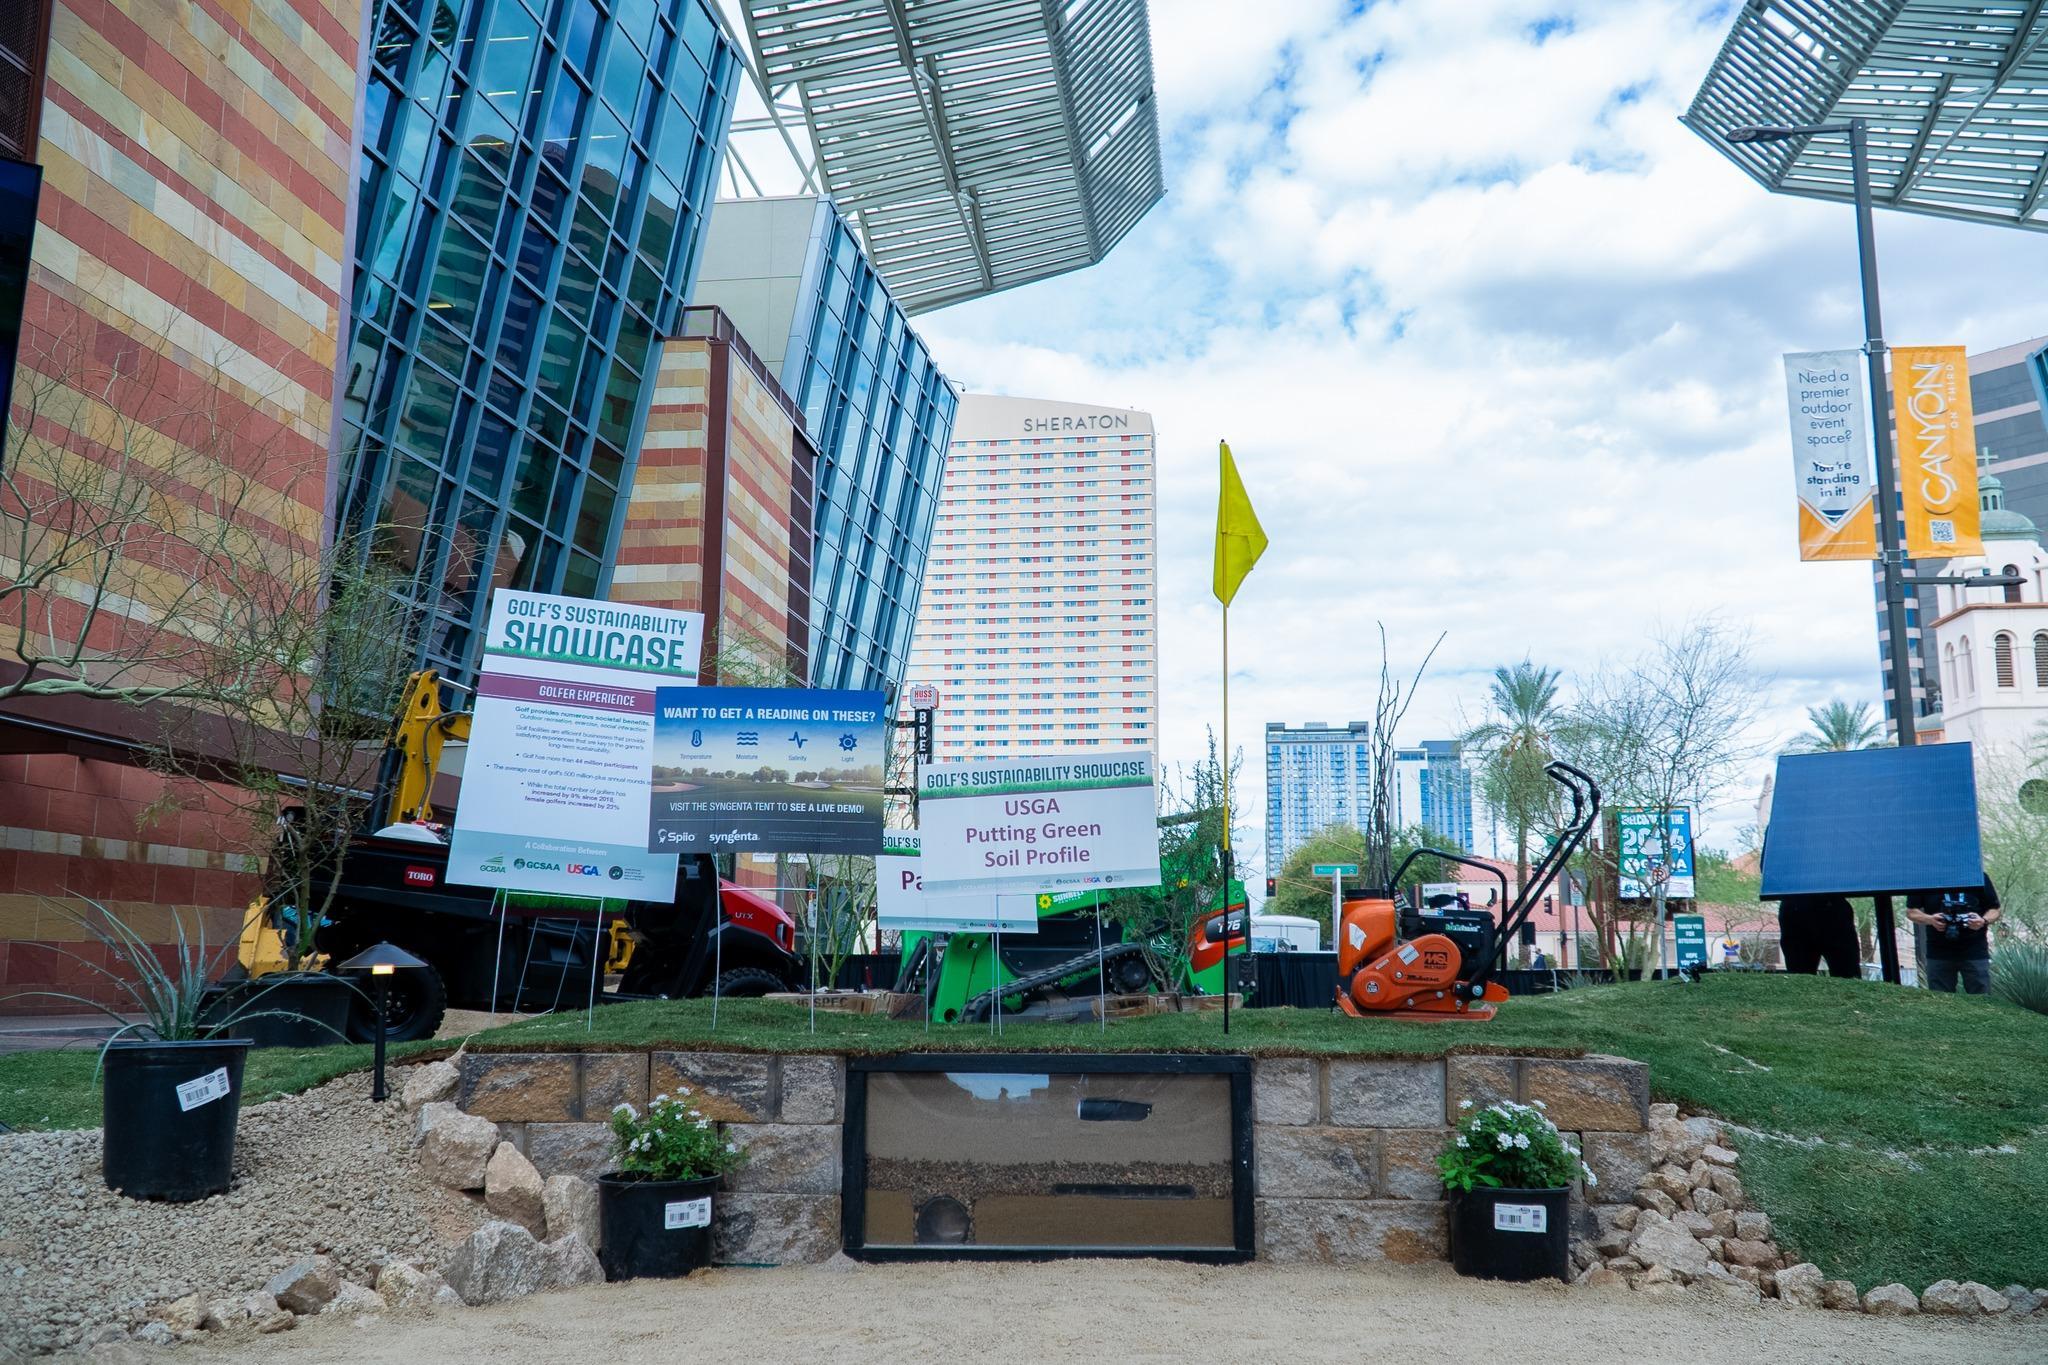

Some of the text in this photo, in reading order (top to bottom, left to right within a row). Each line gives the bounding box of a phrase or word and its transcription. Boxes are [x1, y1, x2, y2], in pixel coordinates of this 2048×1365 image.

[1798, 370, 1849, 384] Need a
[1801, 387, 1850, 402] premier
[1946, 364, 1959, 429] ON THIRD
[1801, 401, 1852, 415] outdoor
[1023, 415, 1128, 432] SHERATON
[1810, 418, 1845, 430] event
[1807, 429, 1852, 447] space?
[1907, 363, 1957, 506] CANYON
[1812, 461, 1852, 472] You're
[1807, 473, 1860, 485] standing
[1820, 487, 1847, 497] in it!
[508, 599, 687, 636] GOLF'S SUSTAINABILITY
[503, 619, 685, 669] SHOWCASE
[539, 685, 635, 706] GOLFER EXPERIENCE
[914, 690, 933, 698] HUSS
[530, 708, 559, 717] provides
[561, 712, 594, 720] numerous
[595, 715, 622, 723] societal
[664, 707, 876, 722] WANT TO GET A READING ON THESE?
[680, 753, 712, 761] Temperature
[788, 754, 807, 762] Salinity
[603, 762, 638, 771] participants
[927, 761, 1145, 789] GOLF'S SUSTAINABILITY SHOWCASE
[532, 789, 560, 798] increased
[561, 791, 570, 799] by
[567, 785, 589, 793] number
[524, 795, 545, 803] female
[546, 797, 567, 806] golfers
[568, 799, 596, 808] increased
[597, 802, 606, 810] by
[670, 802, 865, 814] VISIT THE SYNGENTA TENT TO SEE A LIVE DEMO!
[1004, 797, 1060, 817] USGA
[667, 832, 696, 844] Spiio
[709, 830, 759, 845] syngenta
[966, 820, 1102, 845] Putting Green
[525, 841, 607, 857] A Collaboration Between
[984, 845, 1091, 868] Soil Profile
[479, 864, 506, 874] GCBAA
[526, 860, 561, 872] GCSAA
[567, 863, 599, 876] USGA
[408, 871, 433, 881] TORO
[1084, 876, 1100, 884] USGA
